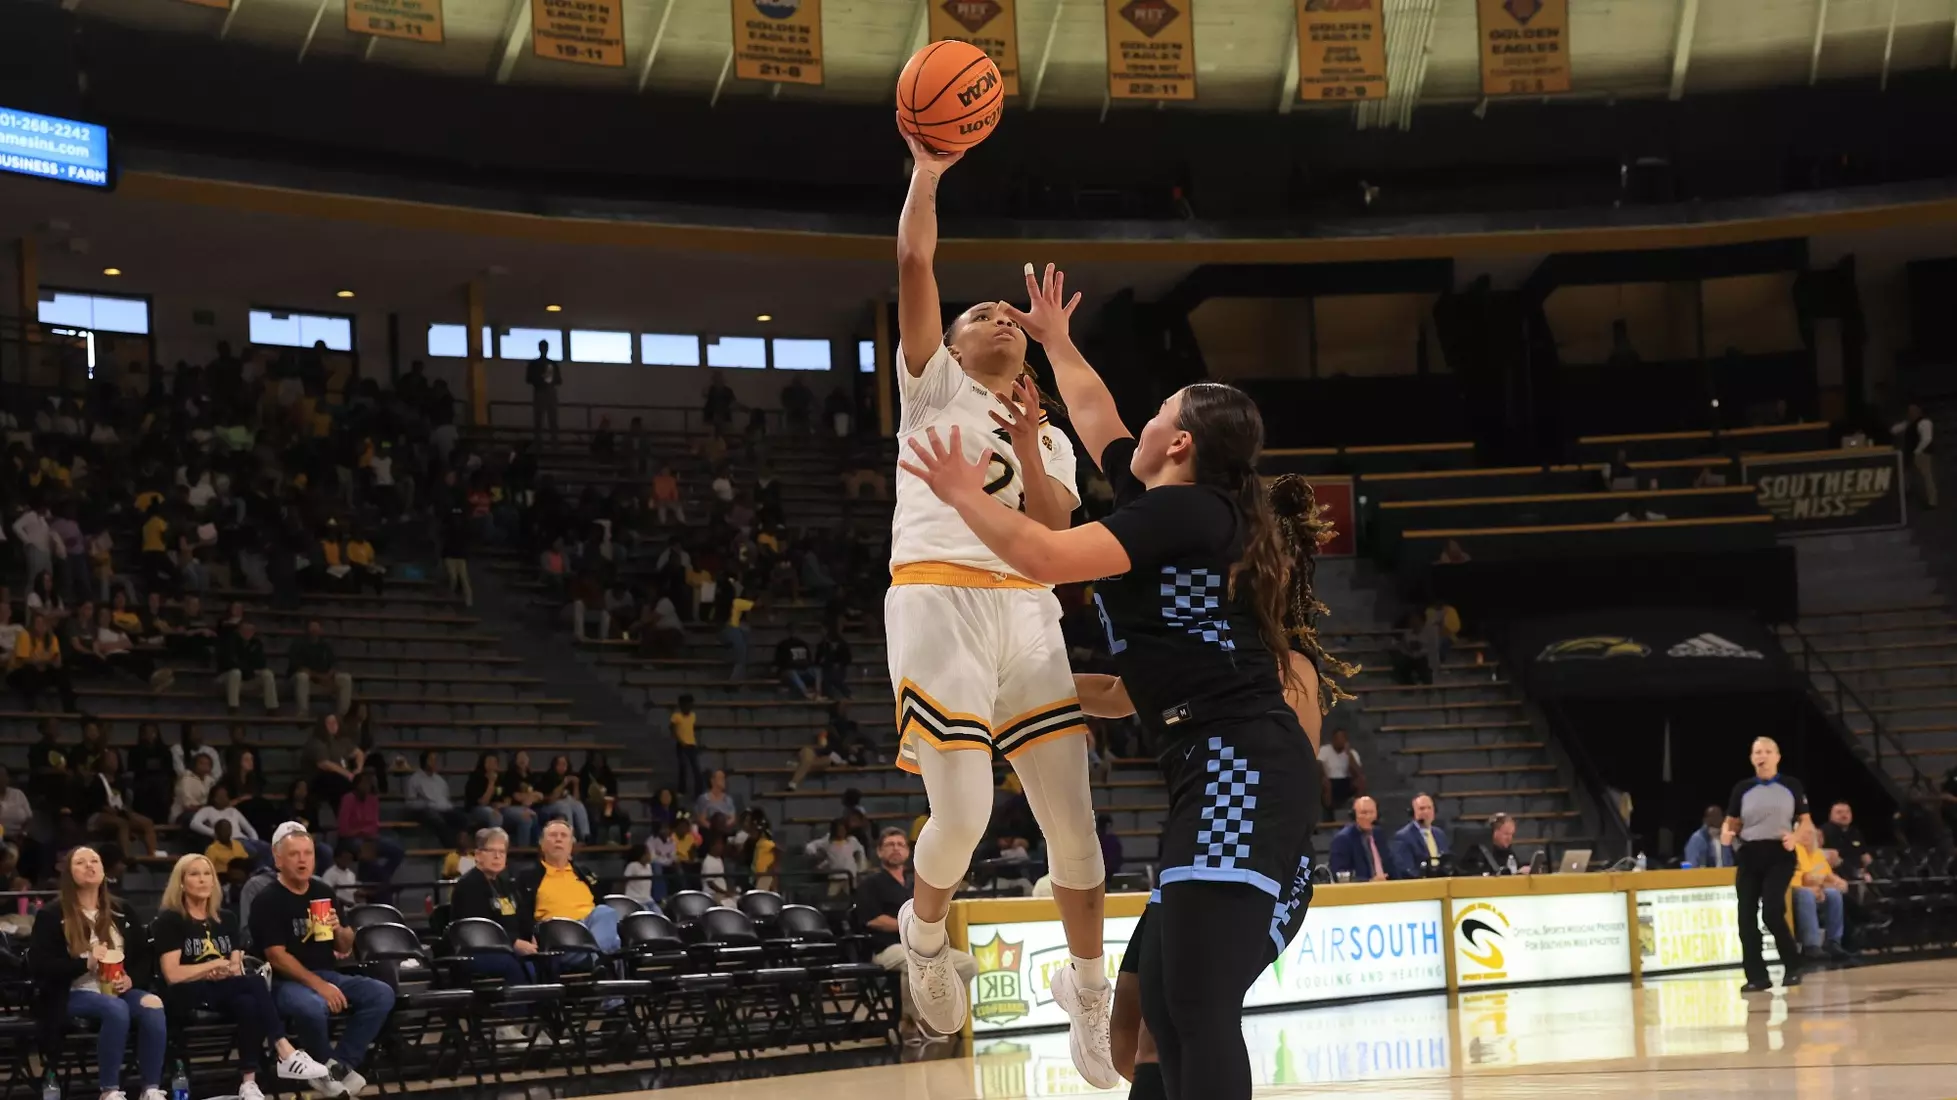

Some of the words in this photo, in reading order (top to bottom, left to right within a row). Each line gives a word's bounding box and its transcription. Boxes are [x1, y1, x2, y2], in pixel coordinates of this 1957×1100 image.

[1489, 27, 1560, 41] GOLDEN
[1491, 40, 1559, 55] EAGLES
[556, 43, 603, 60] 19-11
[957, 69, 998, 107] NCAA
[0, 154, 59, 176] USINESS
[68, 165, 106, 184] FARM
[1757, 466, 1893, 499] SOUTHERN
[1793, 496, 1848, 519] MISS
[1297, 921, 1438, 964] AIRSOUTH
[1661, 932, 1727, 966] GAMEDAY
[1295, 973, 1353, 989] COOLING
[1360, 969, 1384, 983] AND
[1390, 964, 1443, 981] HEATING
